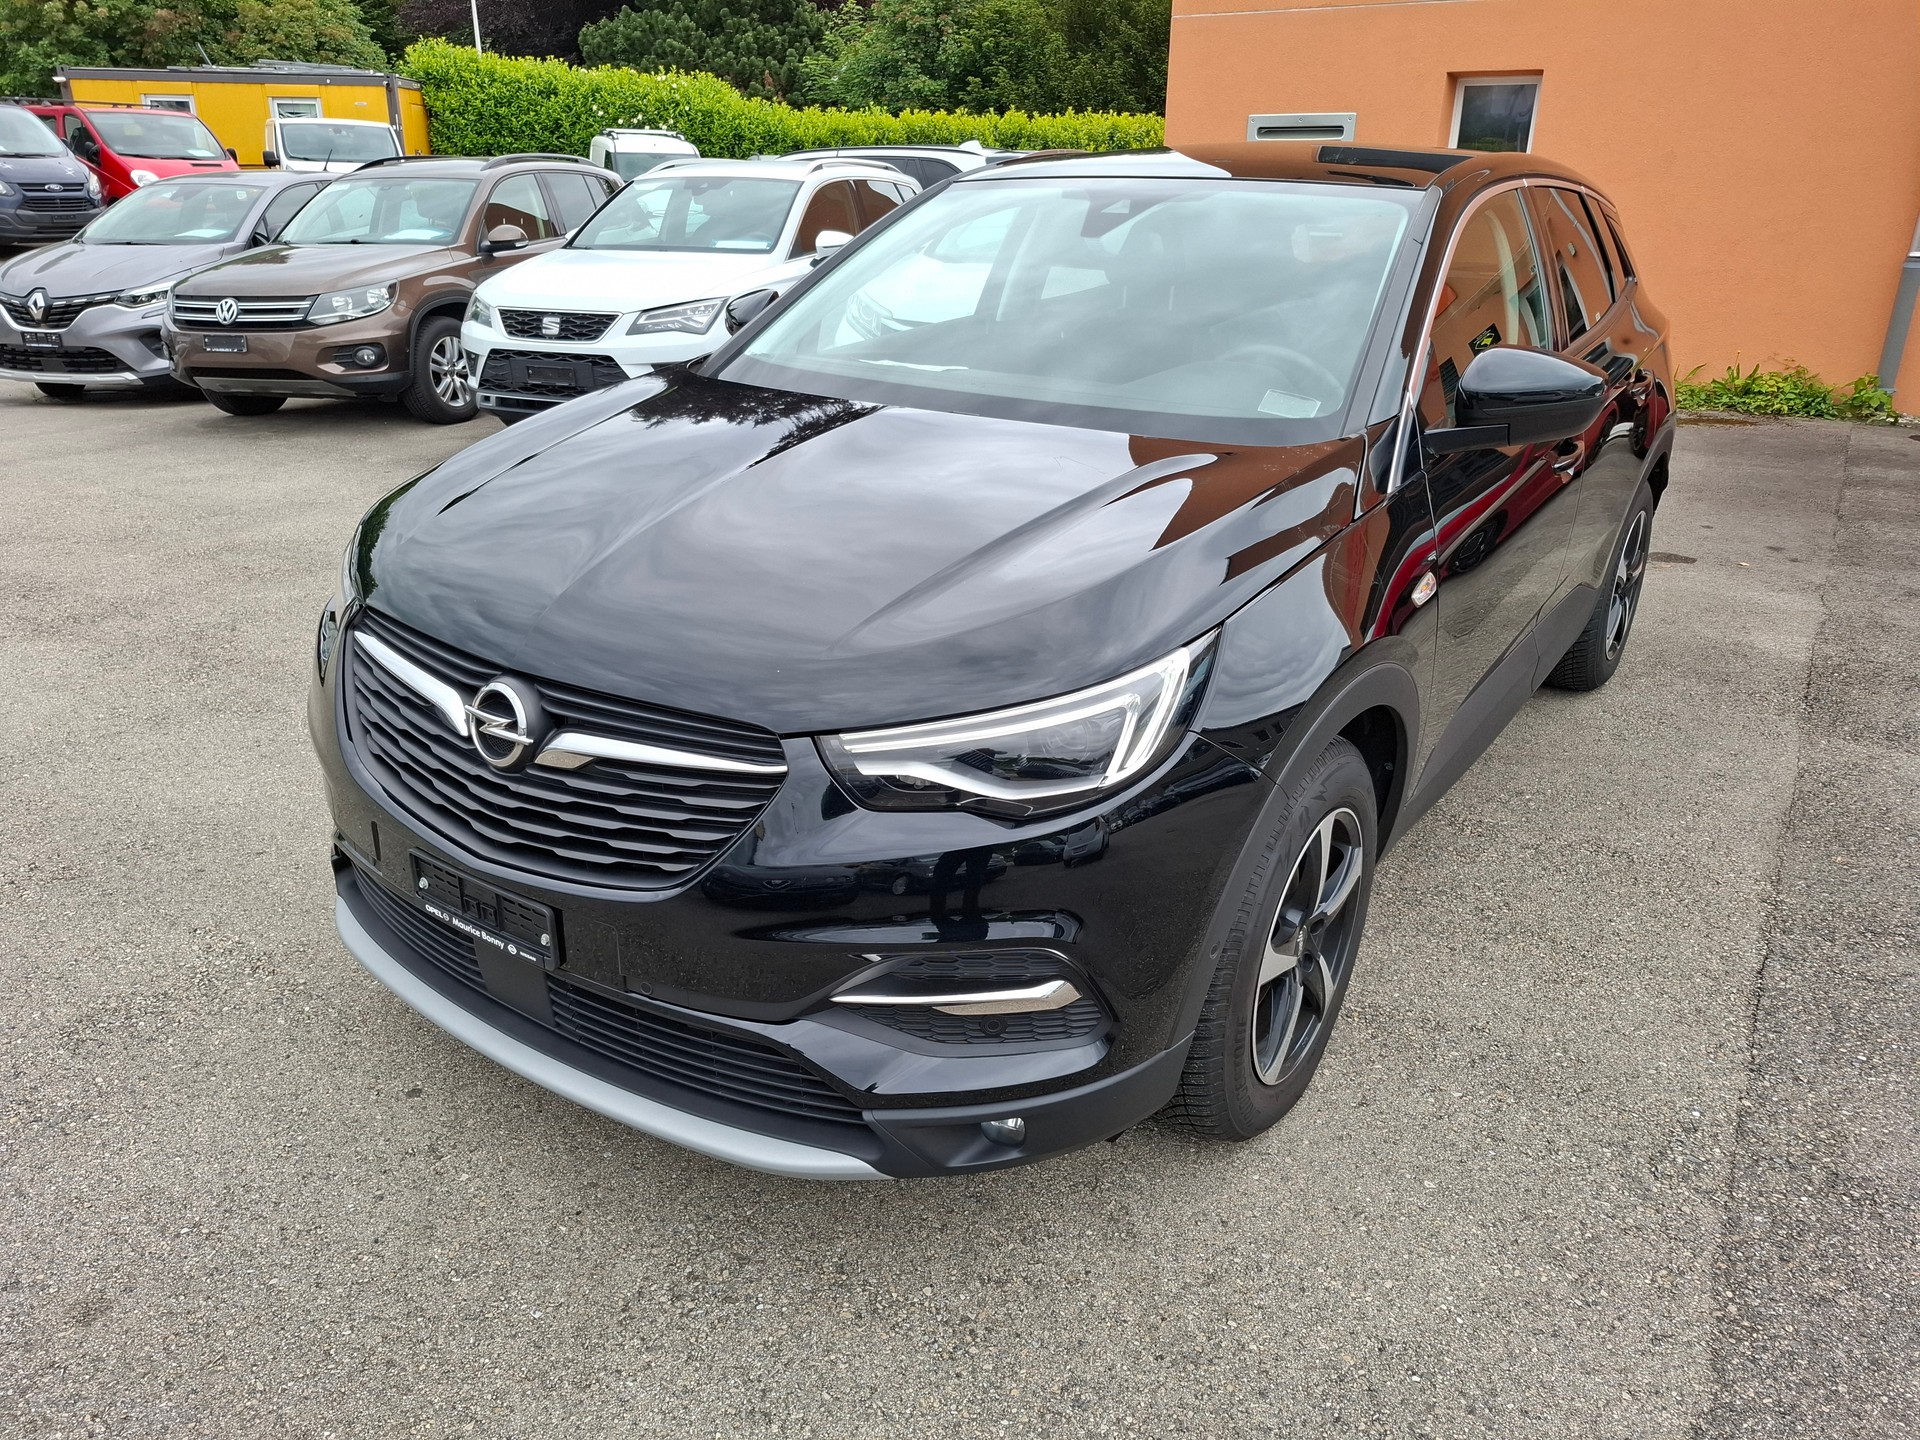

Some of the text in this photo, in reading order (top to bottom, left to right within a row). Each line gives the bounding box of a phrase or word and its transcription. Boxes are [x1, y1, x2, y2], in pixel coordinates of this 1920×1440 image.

[425, 904, 444, 919] OPEL
[452, 917, 481, 938] Maurice
[481, 930, 504, 950] Bonny
